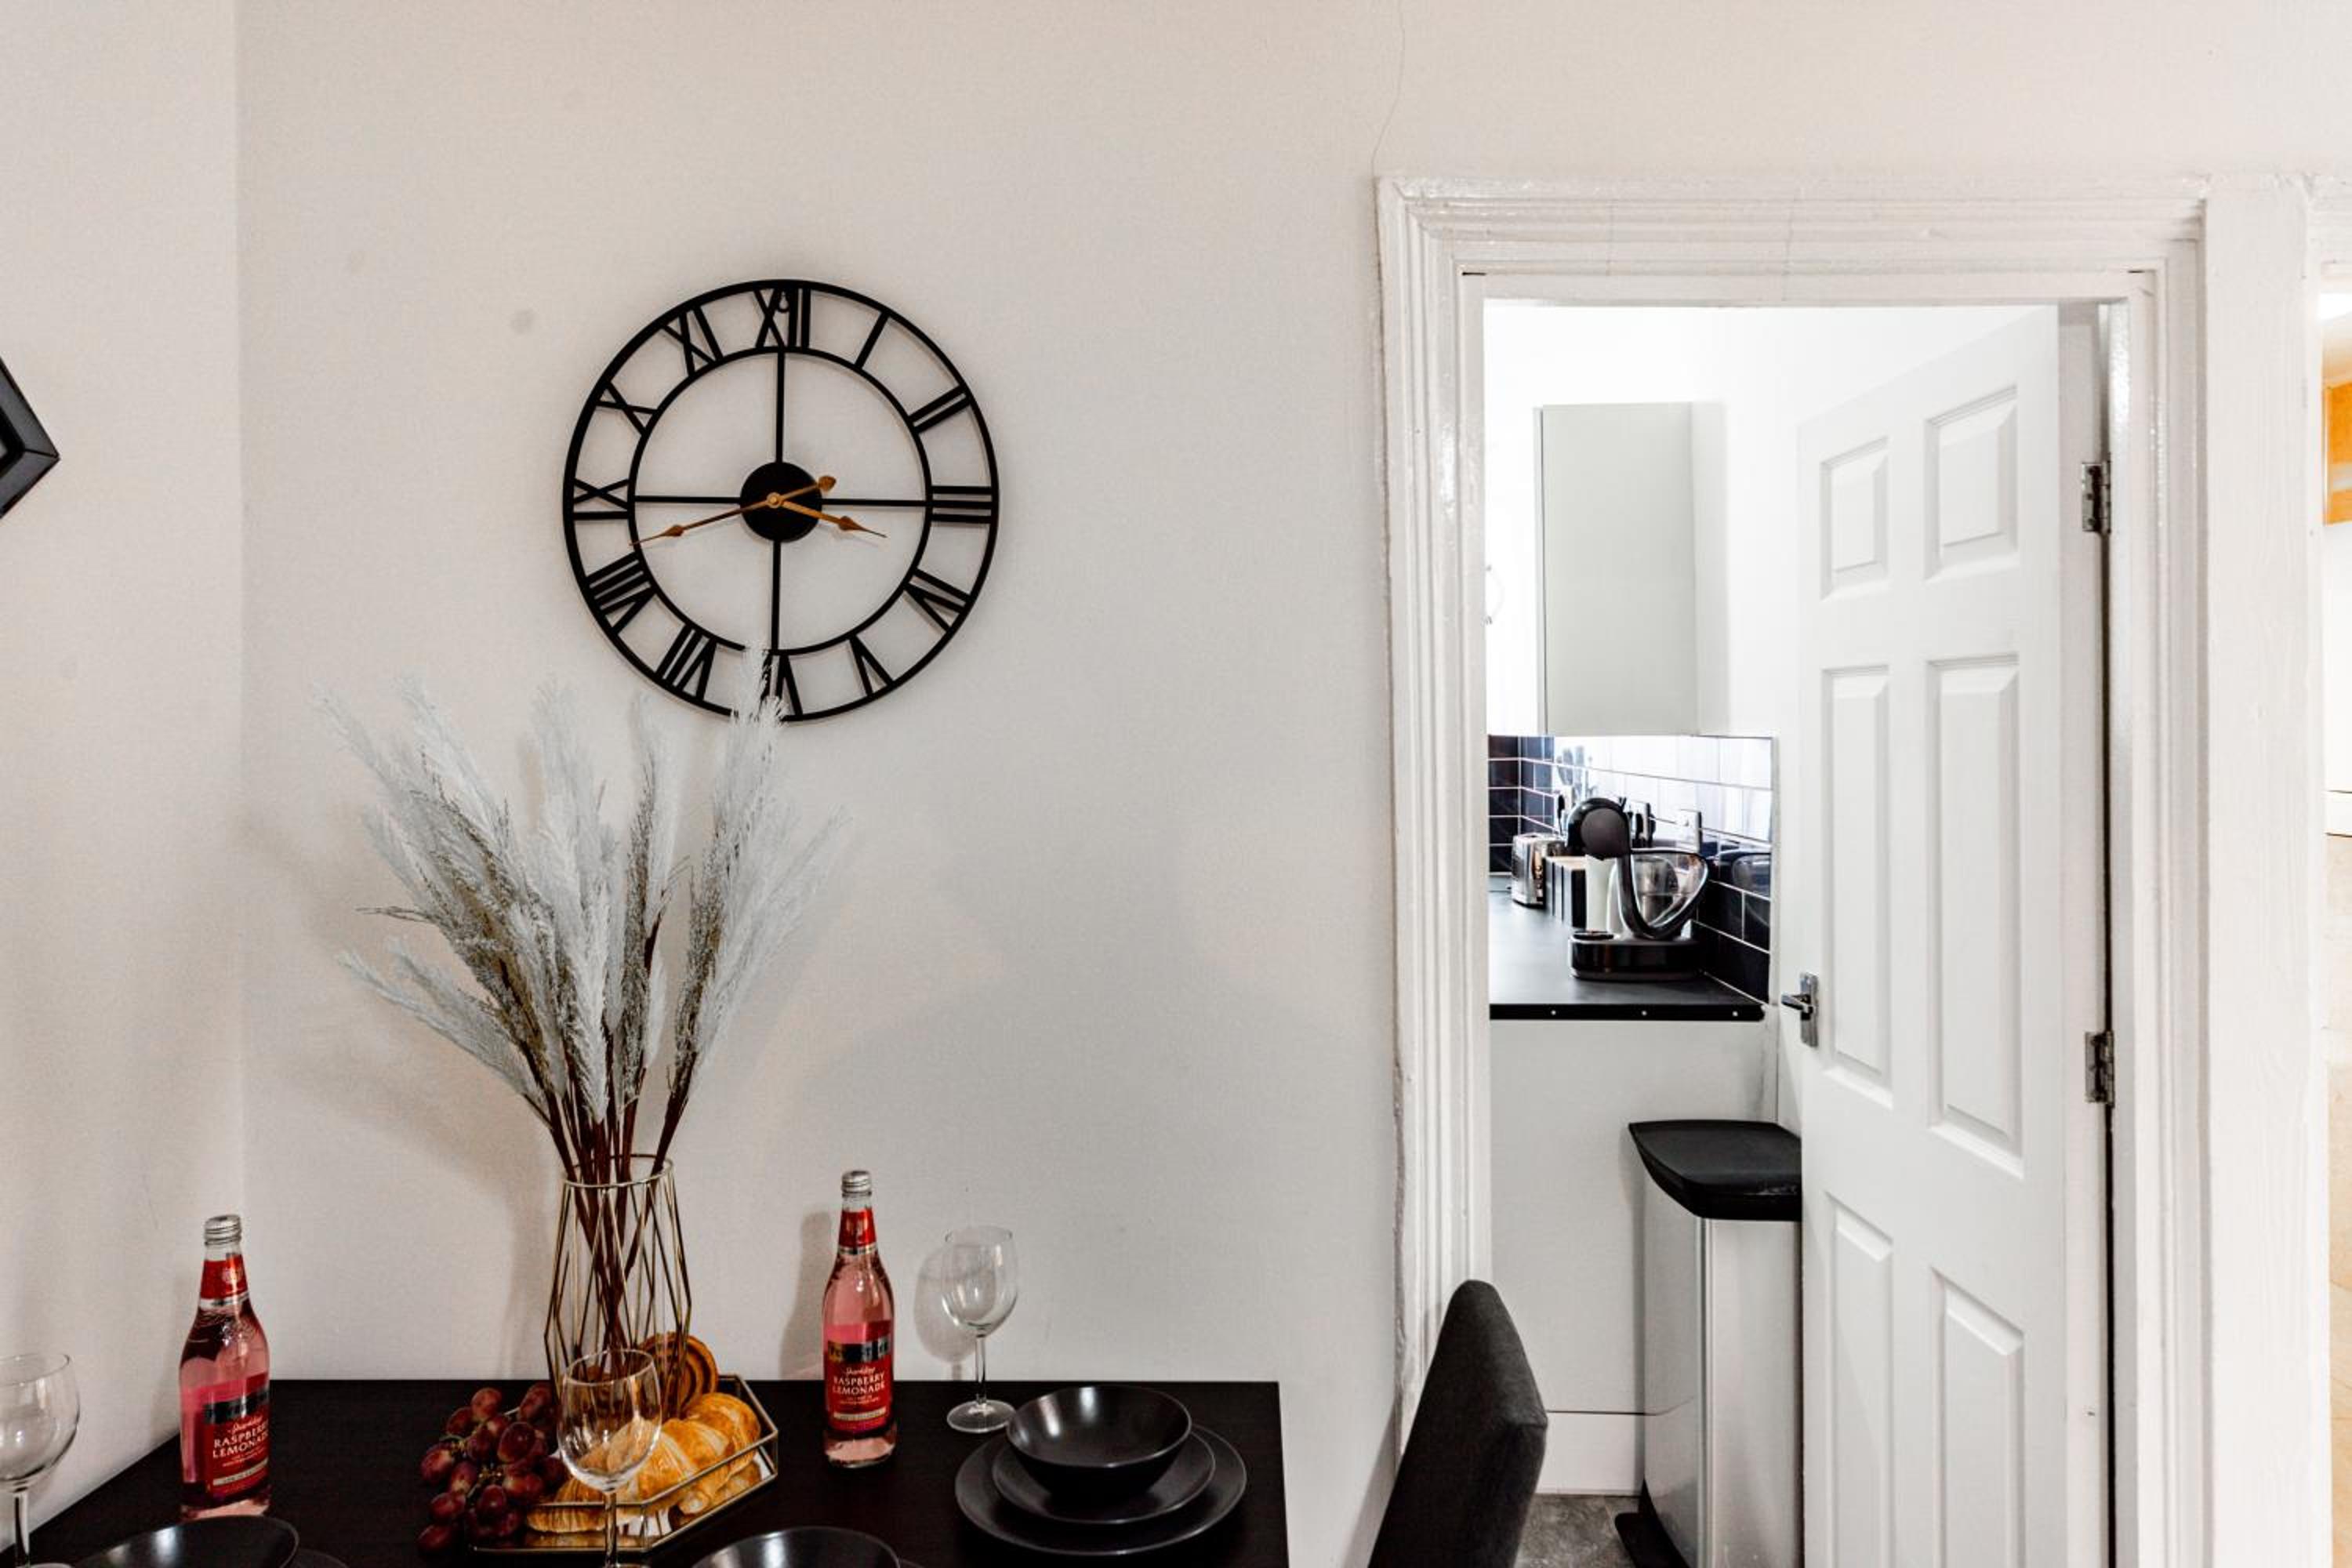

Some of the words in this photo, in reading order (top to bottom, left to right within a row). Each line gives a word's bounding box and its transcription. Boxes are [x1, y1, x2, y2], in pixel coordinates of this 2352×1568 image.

[753, 287, 811, 349] XII
[662, 306, 723, 377] XI
[594, 381, 659, 434] X
[849, 637, 895, 696] V
[832, 1381, 886, 1395] LEMONADE
[833, 1370, 885, 1387] RASPBERRY
[212, 1429, 269, 1459] LEMONAD
[213, 1418, 269, 1449] RASPBERR
